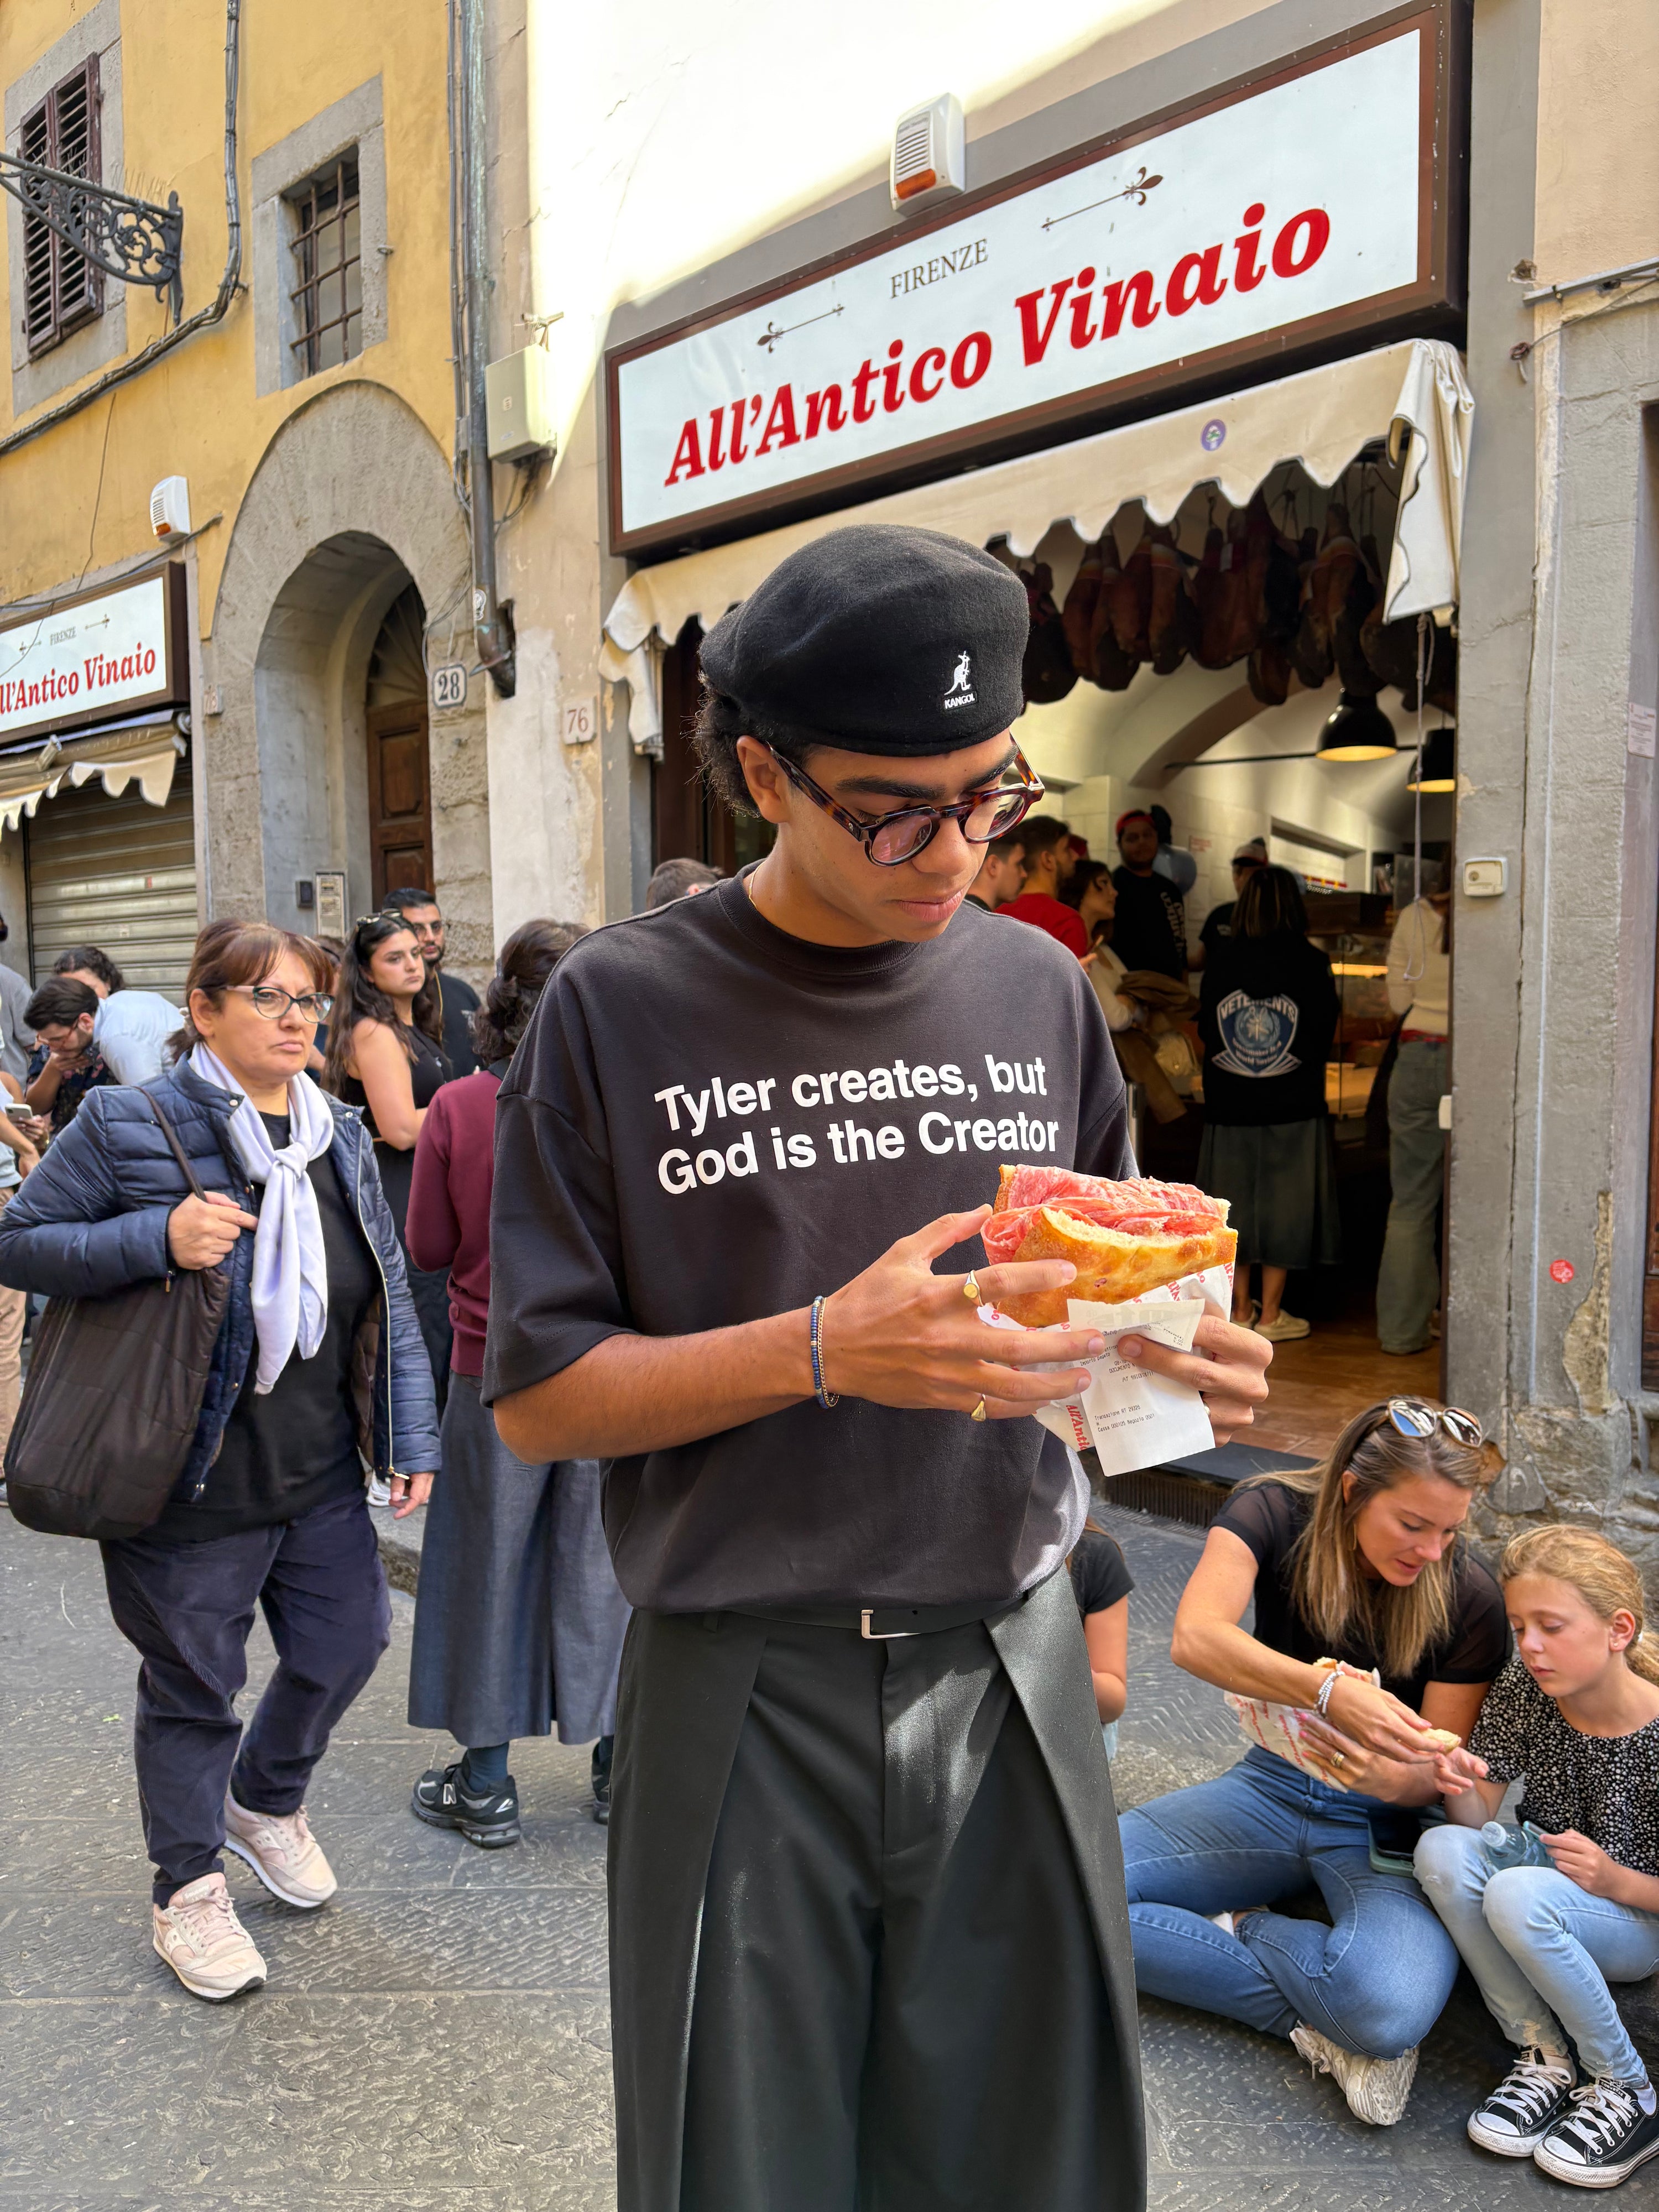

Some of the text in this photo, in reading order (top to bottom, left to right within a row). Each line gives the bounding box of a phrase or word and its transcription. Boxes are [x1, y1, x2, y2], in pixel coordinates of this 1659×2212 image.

[890, 238, 988, 299] FIRENZE
[665, 204, 1329, 486] All'Antico Vinaio
[50, 627, 76, 646] FIRENZE
[84, 642, 155, 691] Vinaio
[438, 671, 460, 702] 28
[567, 707, 588, 734] 76
[945, 693, 975, 709] KANGOL
[654, 1054, 1047, 1138] Tyler creates, but
[658, 1111, 1060, 1194] God is the Creator
[443, 1783, 457, 1804] N
